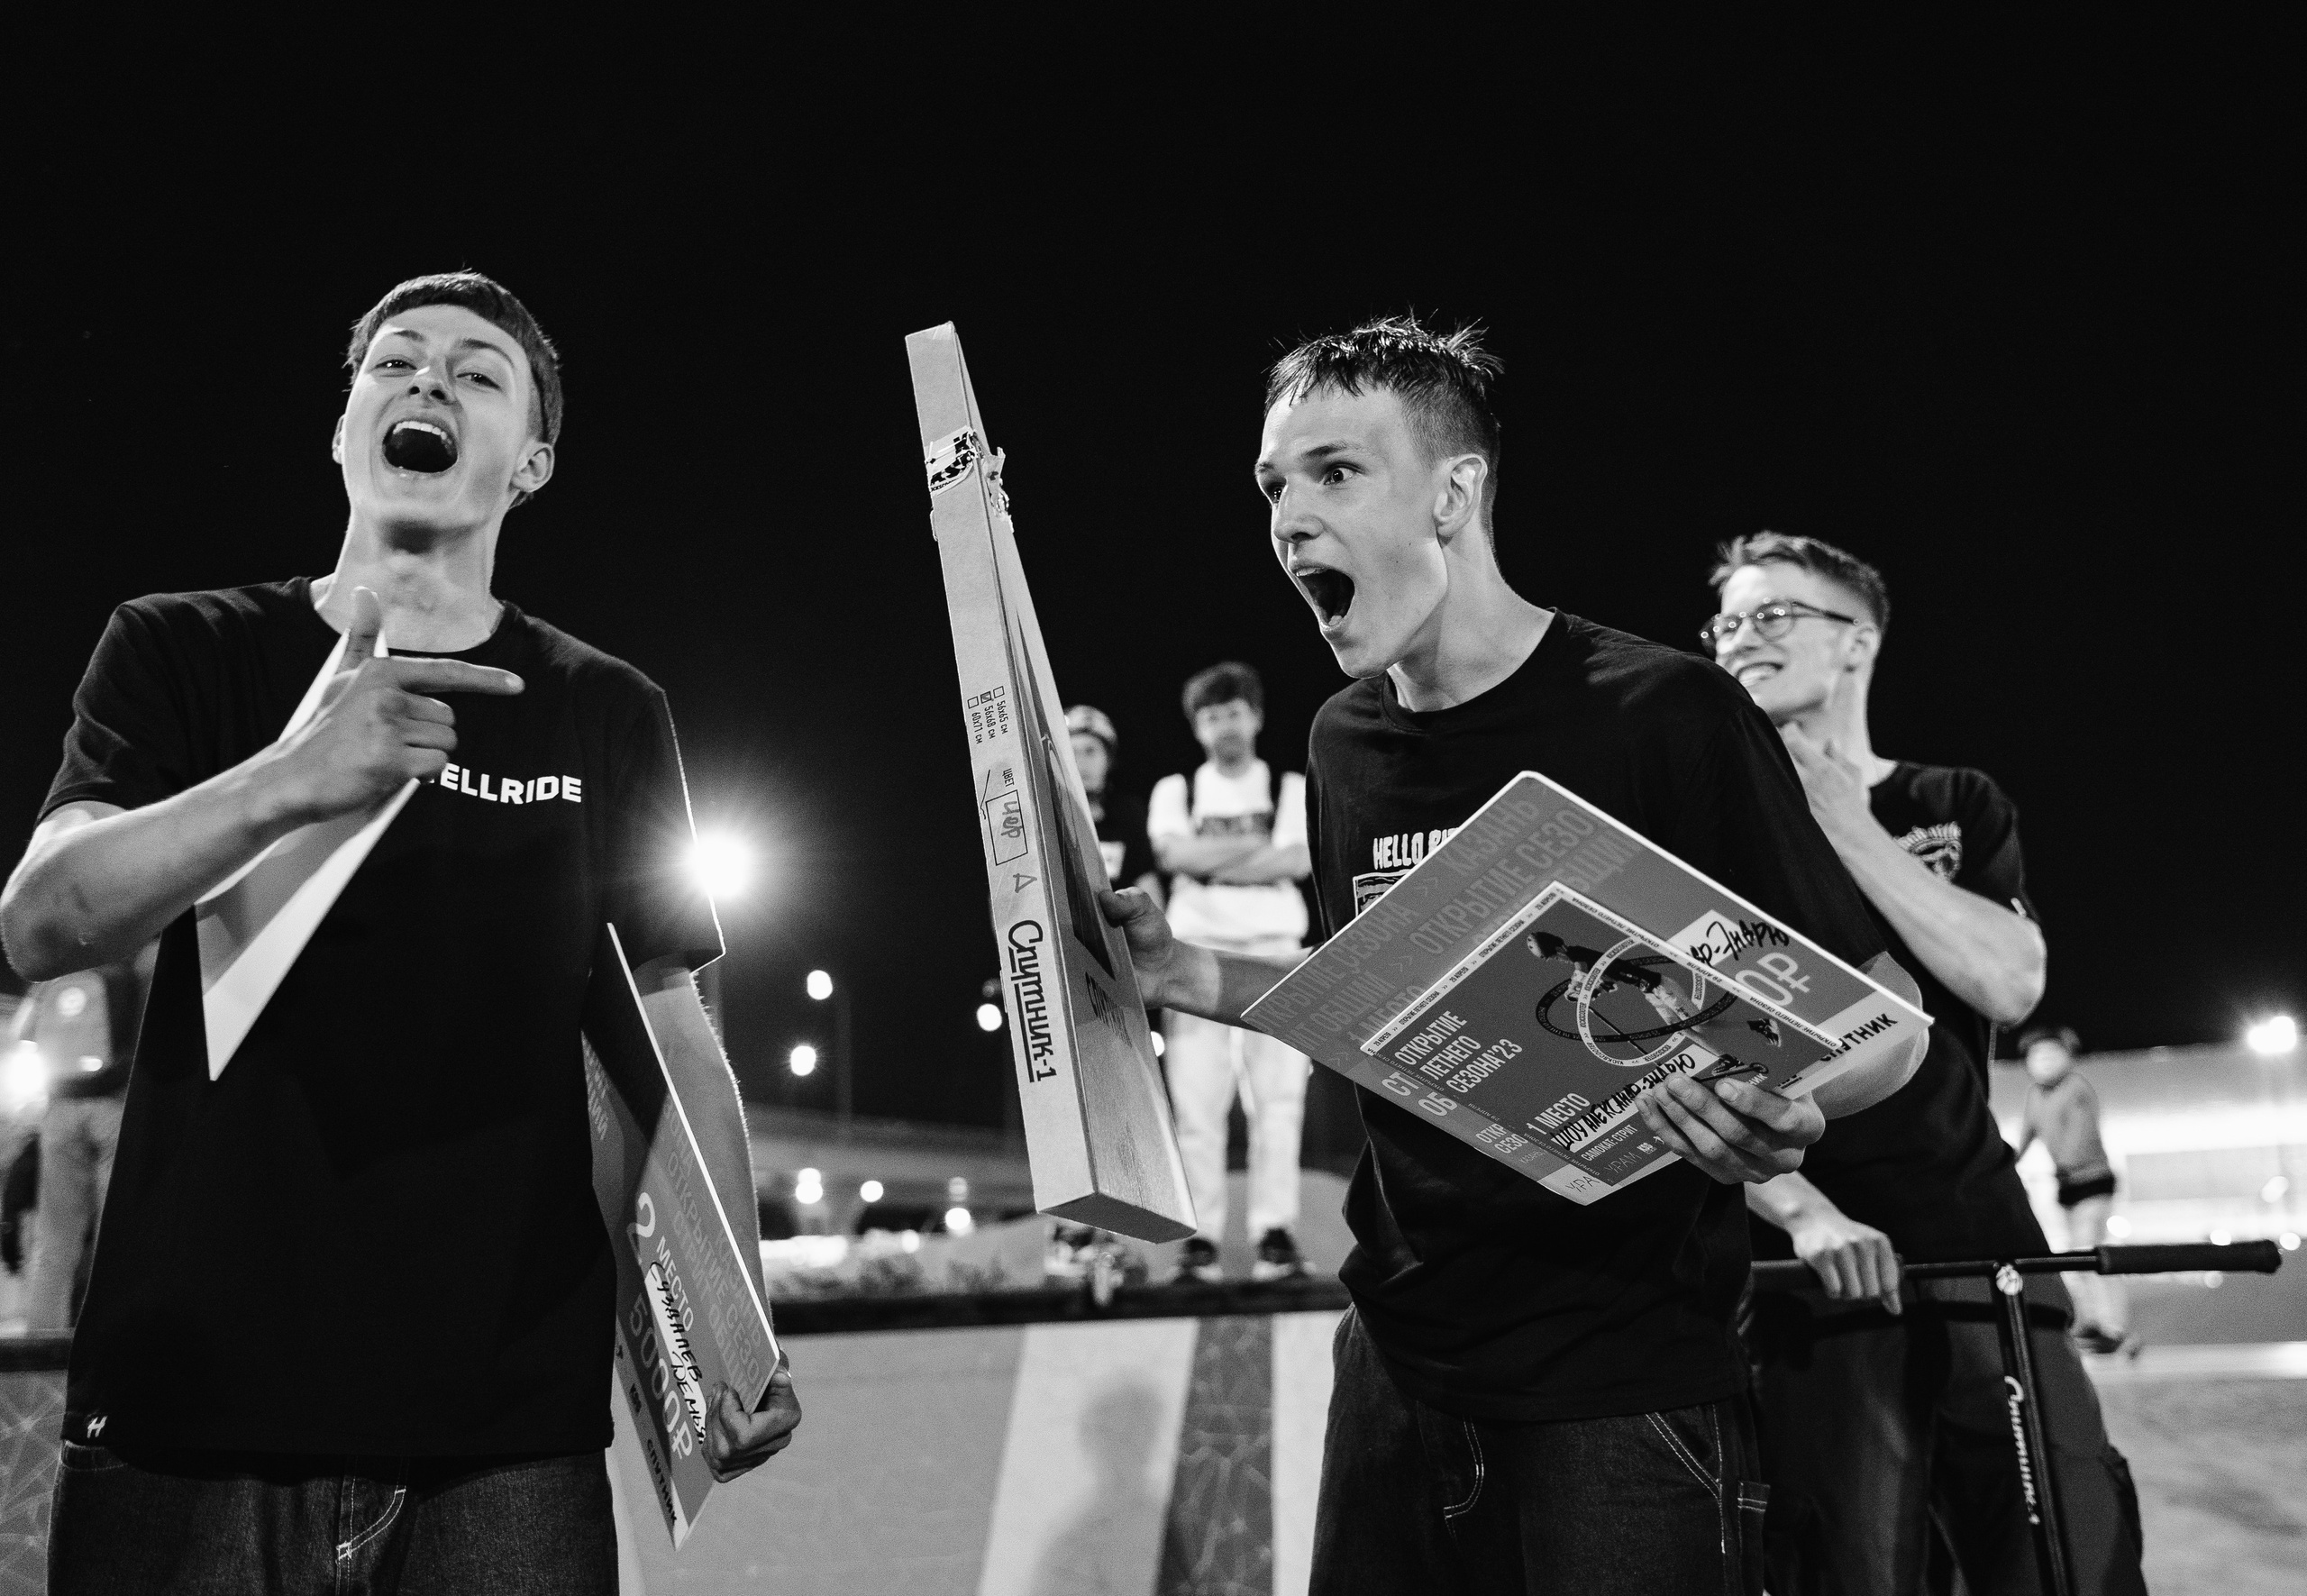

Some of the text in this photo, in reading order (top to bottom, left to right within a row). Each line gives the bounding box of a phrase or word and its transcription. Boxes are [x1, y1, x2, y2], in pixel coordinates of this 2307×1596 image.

[440, 762, 582, 804] ELLRIDE
[1002, 768, 1015, 788] ЦВЕТ
[1372, 832, 1424, 871] HELLO
[1008, 919, 1057, 1082] Спутник-1
[1735, 952, 1810, 1007] 0₽
[1394, 1010, 1468, 1066] ОТКРЫТИЕ
[1419, 1035, 1482, 1081] ЛЕТНЕГО
[1475, 1123, 1508, 1145] ОТКР
[1527, 1092, 1591, 1135] 1 МЕСТО
[1494, 1133, 1528, 1154] СЕЗО
[1579, 1123, 1639, 1162] САМОКАТ: СТРИТ
[1565, 1175, 1600, 1194] УРА
[657, 1236, 694, 1331] МЕСТО
[725, 1300, 761, 1387] СЕЗО
